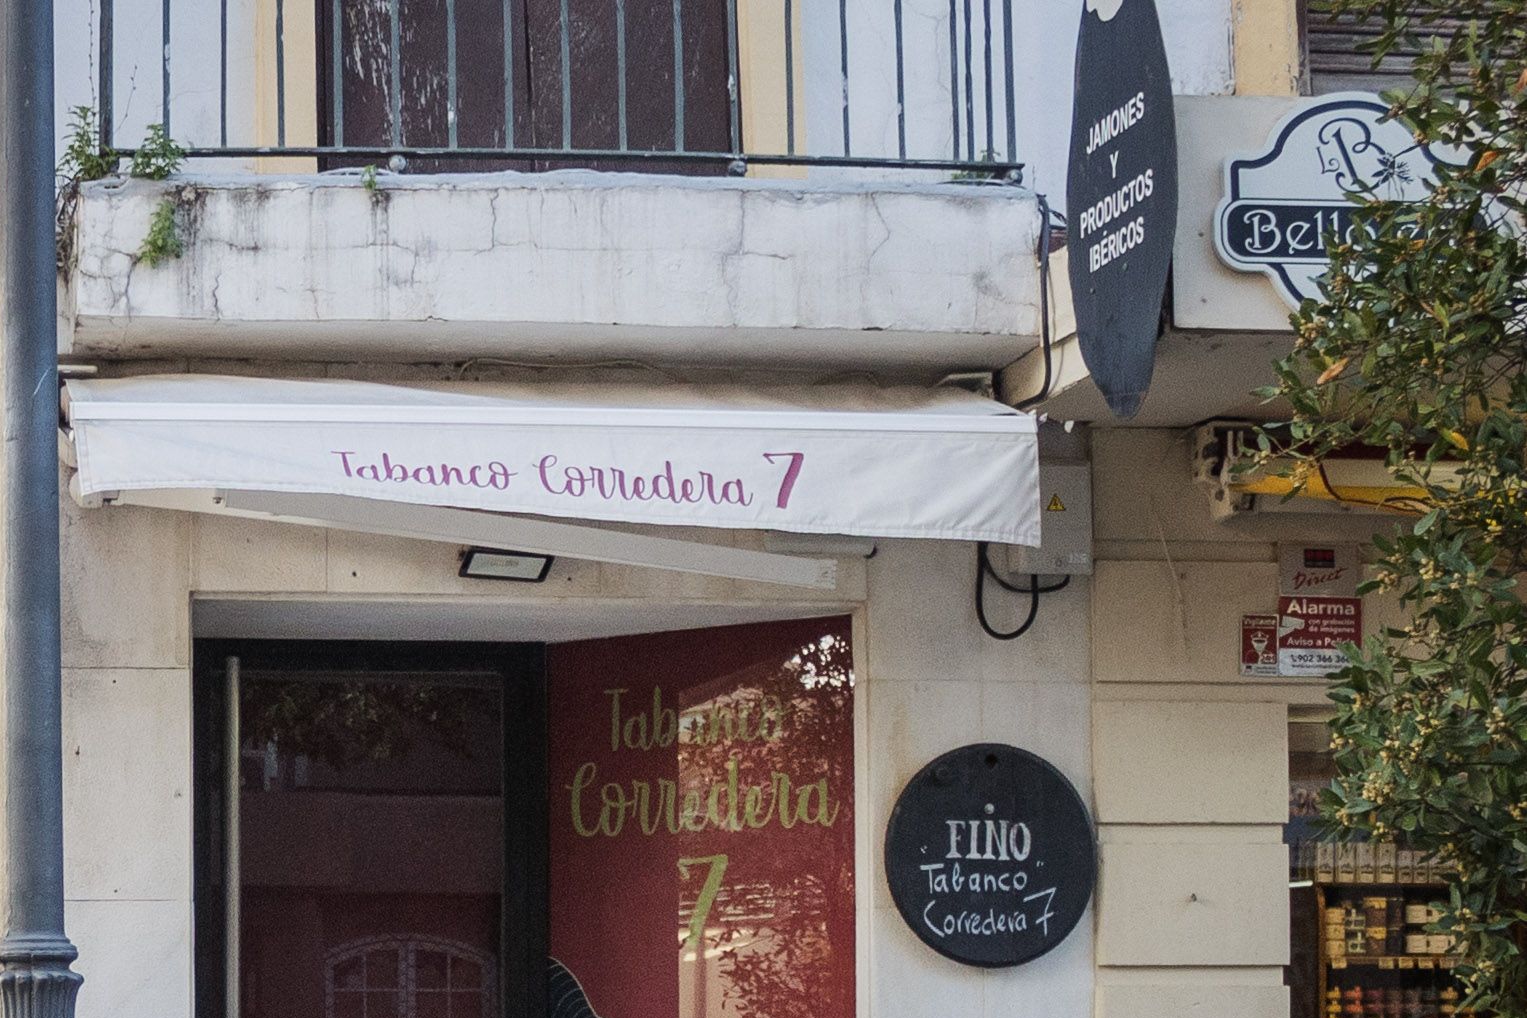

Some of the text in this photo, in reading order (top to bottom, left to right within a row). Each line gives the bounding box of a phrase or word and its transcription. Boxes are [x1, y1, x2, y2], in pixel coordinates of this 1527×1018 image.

[1086, 92, 1144, 155] JAMONES
[1110, 151, 1119, 179] Y
[1080, 168, 1154, 239] PRODUCTOS
[1089, 216, 1144, 273] IBÉRICOS
[331, 450, 804, 508] Tabanco Corredera 7
[1286, 599, 1355, 615] Alarma
[1287, 637, 1314, 646] Aviso
[604, 686, 790, 751] Tabanco
[565, 756, 840, 837] Corredera
[945, 819, 1032, 861] FINO
[677, 854, 728, 950] 7
[924, 887, 1057, 938] Corredera 7
